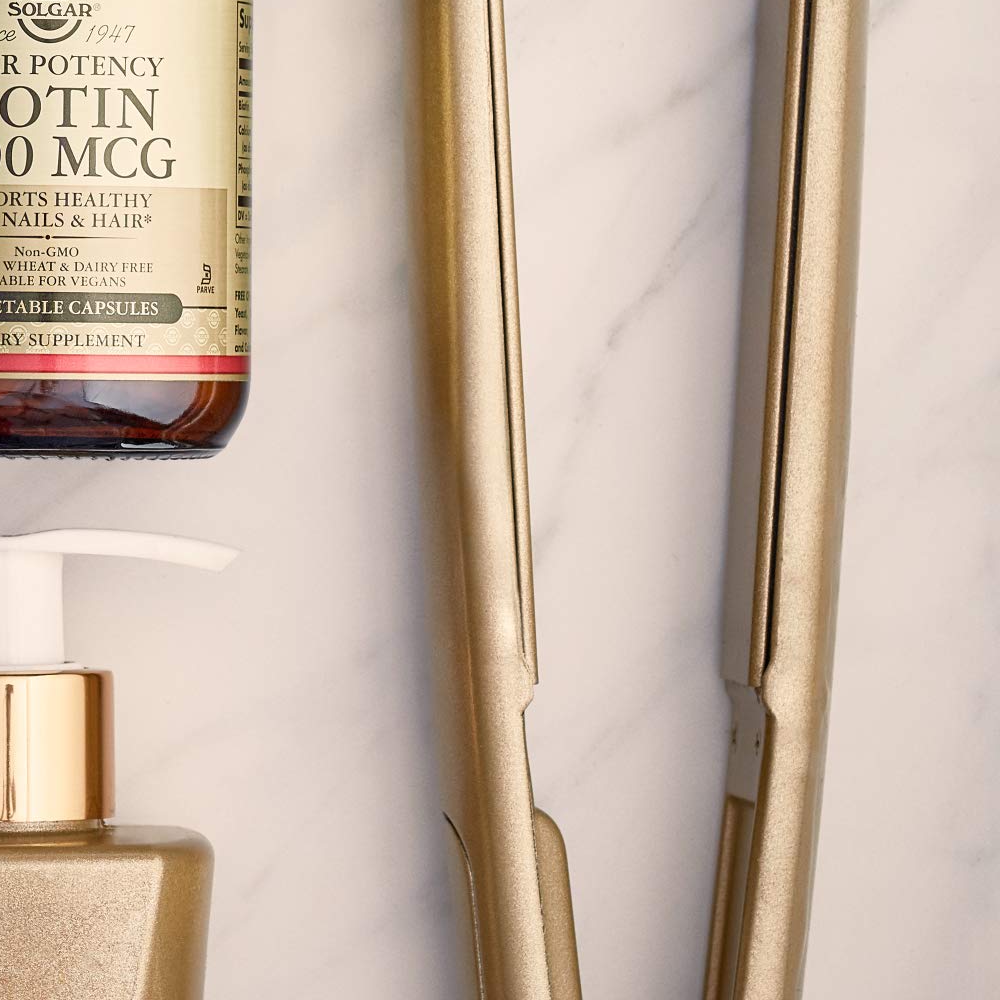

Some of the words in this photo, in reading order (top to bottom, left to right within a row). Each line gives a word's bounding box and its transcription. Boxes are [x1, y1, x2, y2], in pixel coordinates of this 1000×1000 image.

[85, 24, 135, 44] 1947
[29, 55, 164, 77] POTENCY
[51, 136, 176, 179] MCG
[54, 192, 152, 208] HEALTHY
[2, 212, 64, 228] NAILS
[71, 214, 85, 228] &
[14, 246, 79, 258] Non-GMO
[2, 261, 56, 272] WHEAT
[59, 262, 70, 272] &
[74, 262, 118, 273] DAIRY
[122, 263, 153, 273] FREE
[38, 276, 66, 287] FOR
[71, 276, 126, 288] VEGANS
[196, 286, 215, 294] PARVE
[68, 301, 159, 316] CAPSULES
[29, 332, 146, 348] SUPPLEMENT
